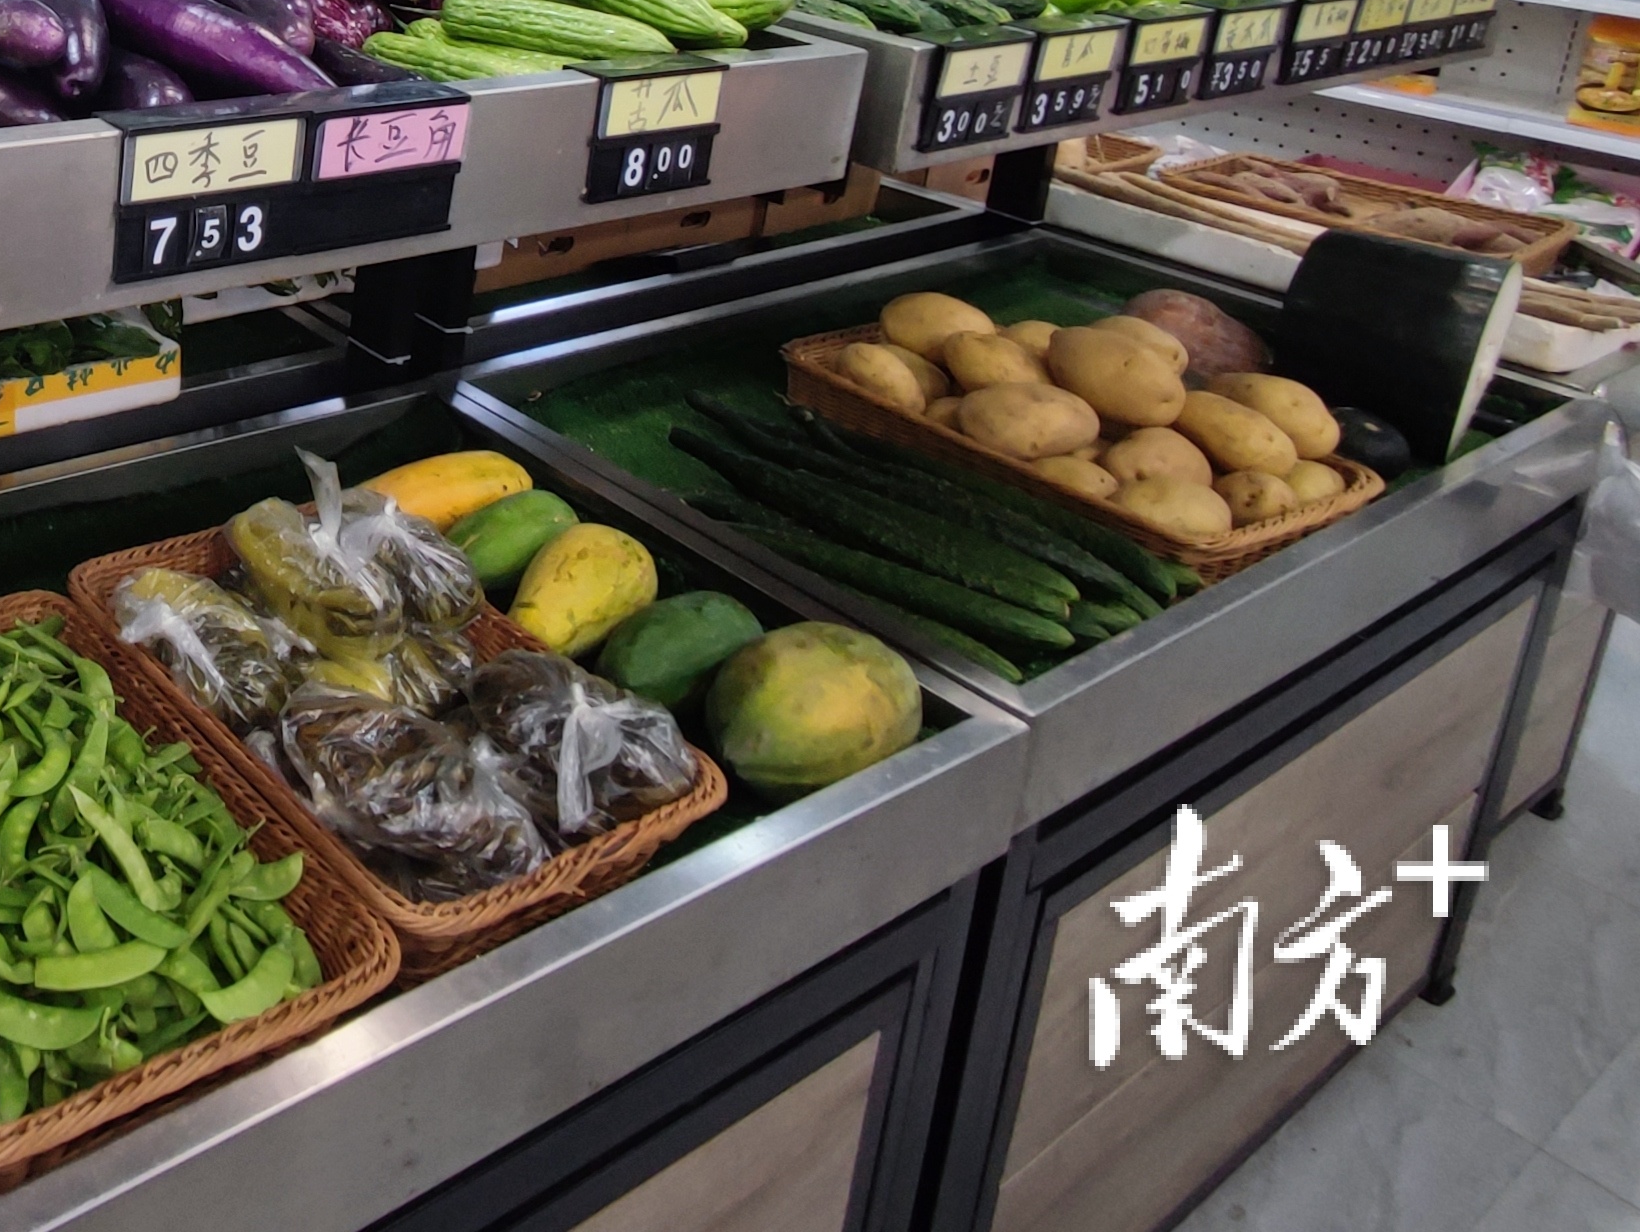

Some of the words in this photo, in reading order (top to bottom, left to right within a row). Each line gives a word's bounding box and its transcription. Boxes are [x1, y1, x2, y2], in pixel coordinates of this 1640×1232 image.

[144, 129, 267, 188] 四季豆
[336, 110, 456, 173] 长豆角
